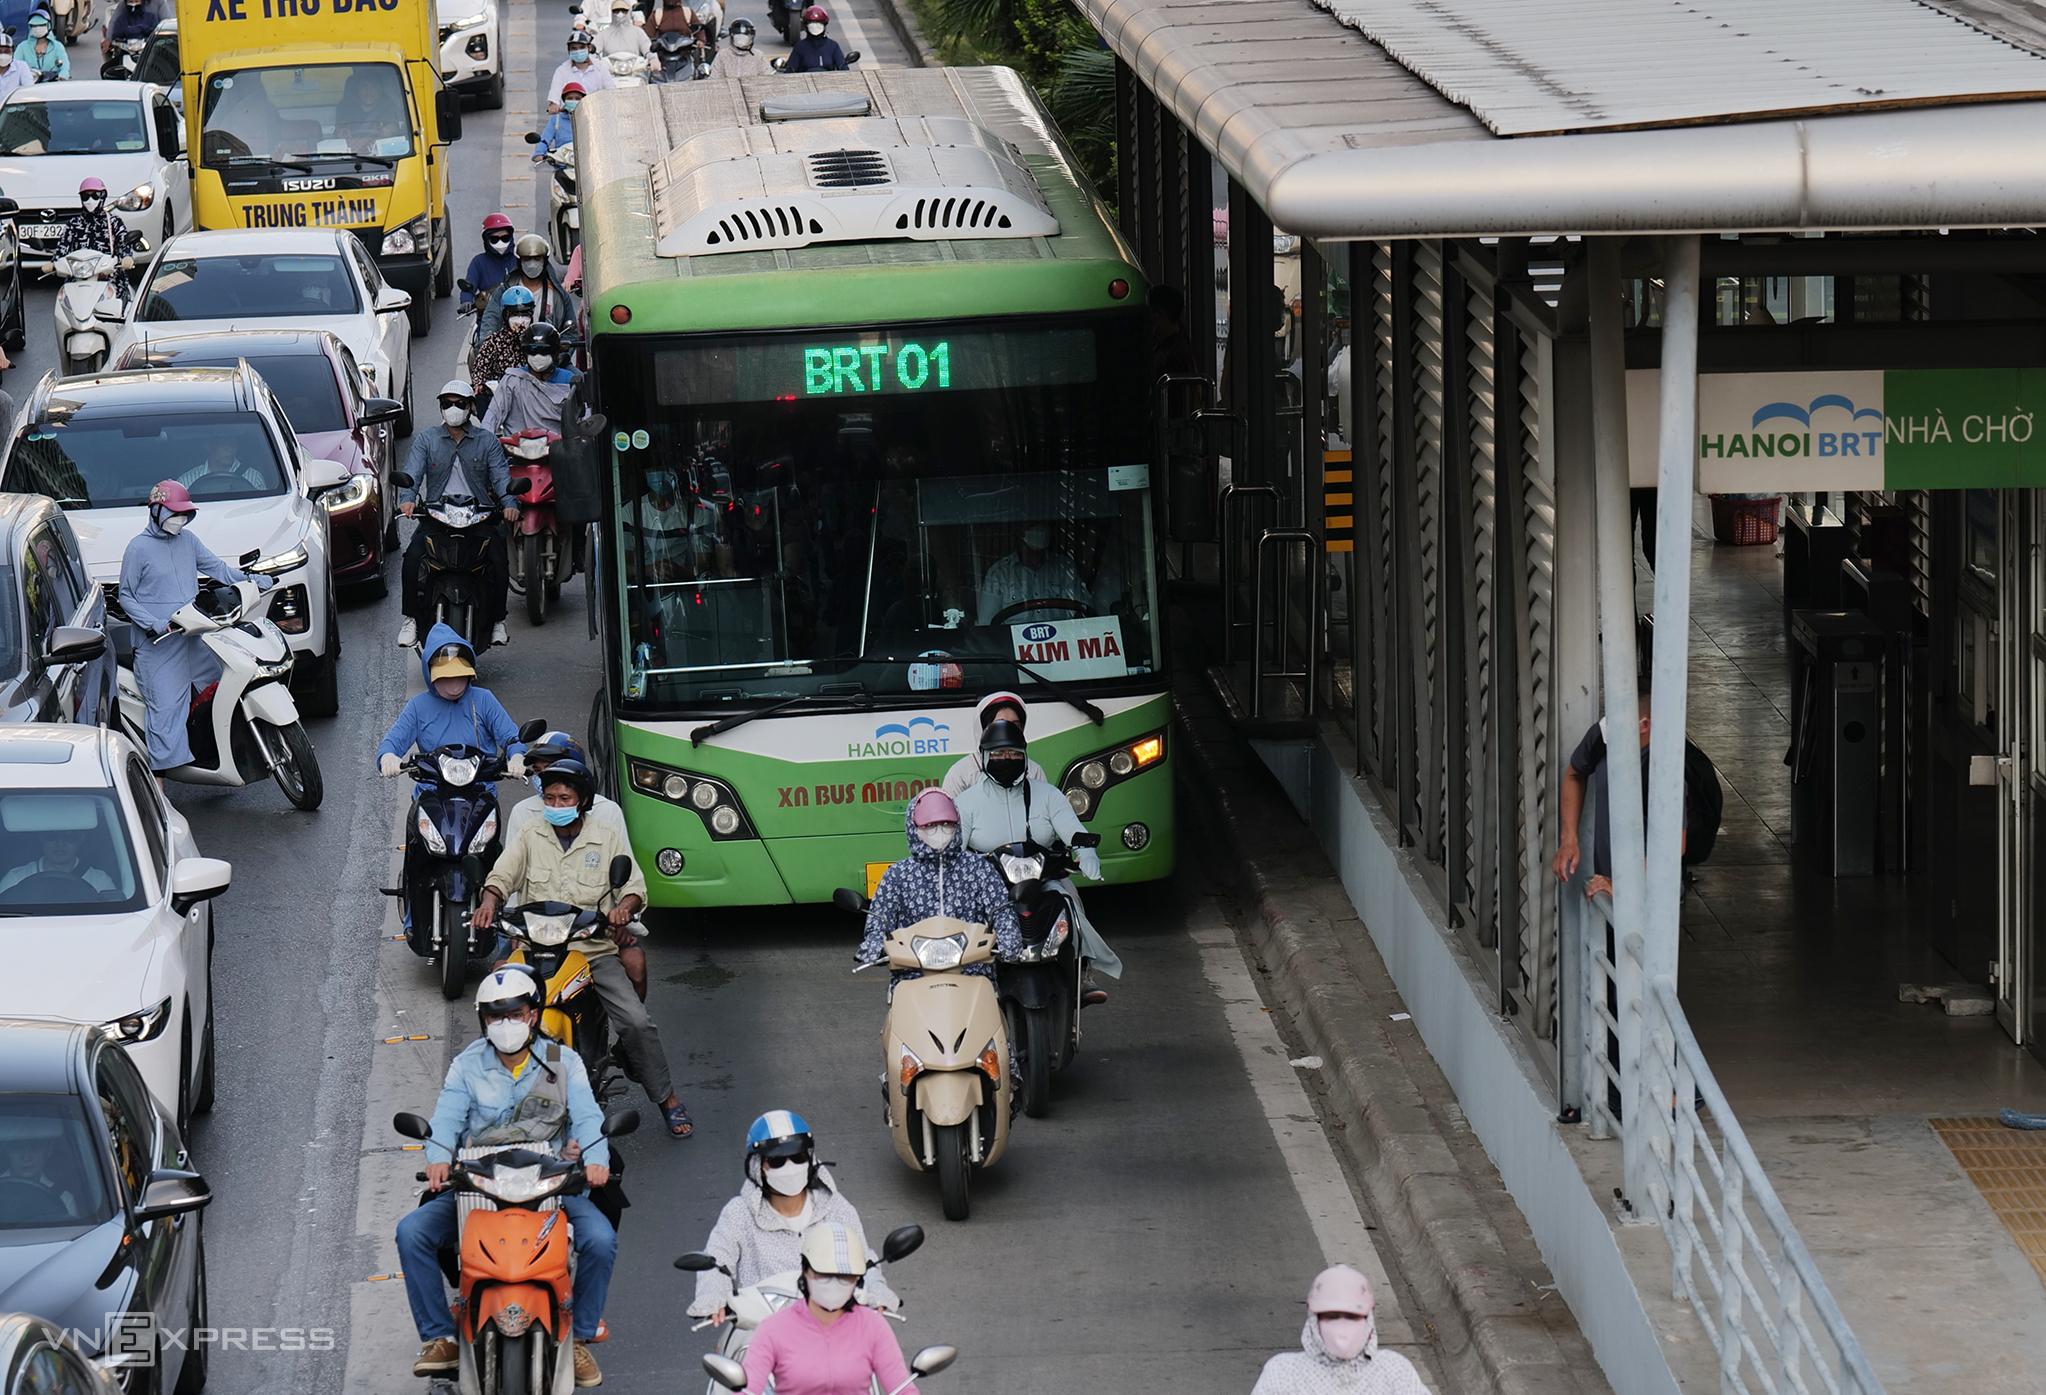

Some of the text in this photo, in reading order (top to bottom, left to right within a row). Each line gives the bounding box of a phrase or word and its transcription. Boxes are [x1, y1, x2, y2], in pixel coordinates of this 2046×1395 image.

[283, 178, 336, 192] ISUZU
[242, 195, 376, 228] TRUNG THÀNH
[20, 226, 63, 238] 30F-292
[804, 342, 950, 394] BRT 01
[1885, 406, 2034, 444] NHÀ CHỜ
[1701, 432, 1882, 458] HANOI BRT
[1029, 626, 1050, 640] BRT
[1018, 631, 1121, 662] KIM MÃ
[848, 738, 949, 757] HANOI BRT
[815, 783, 855, 806] BUS
